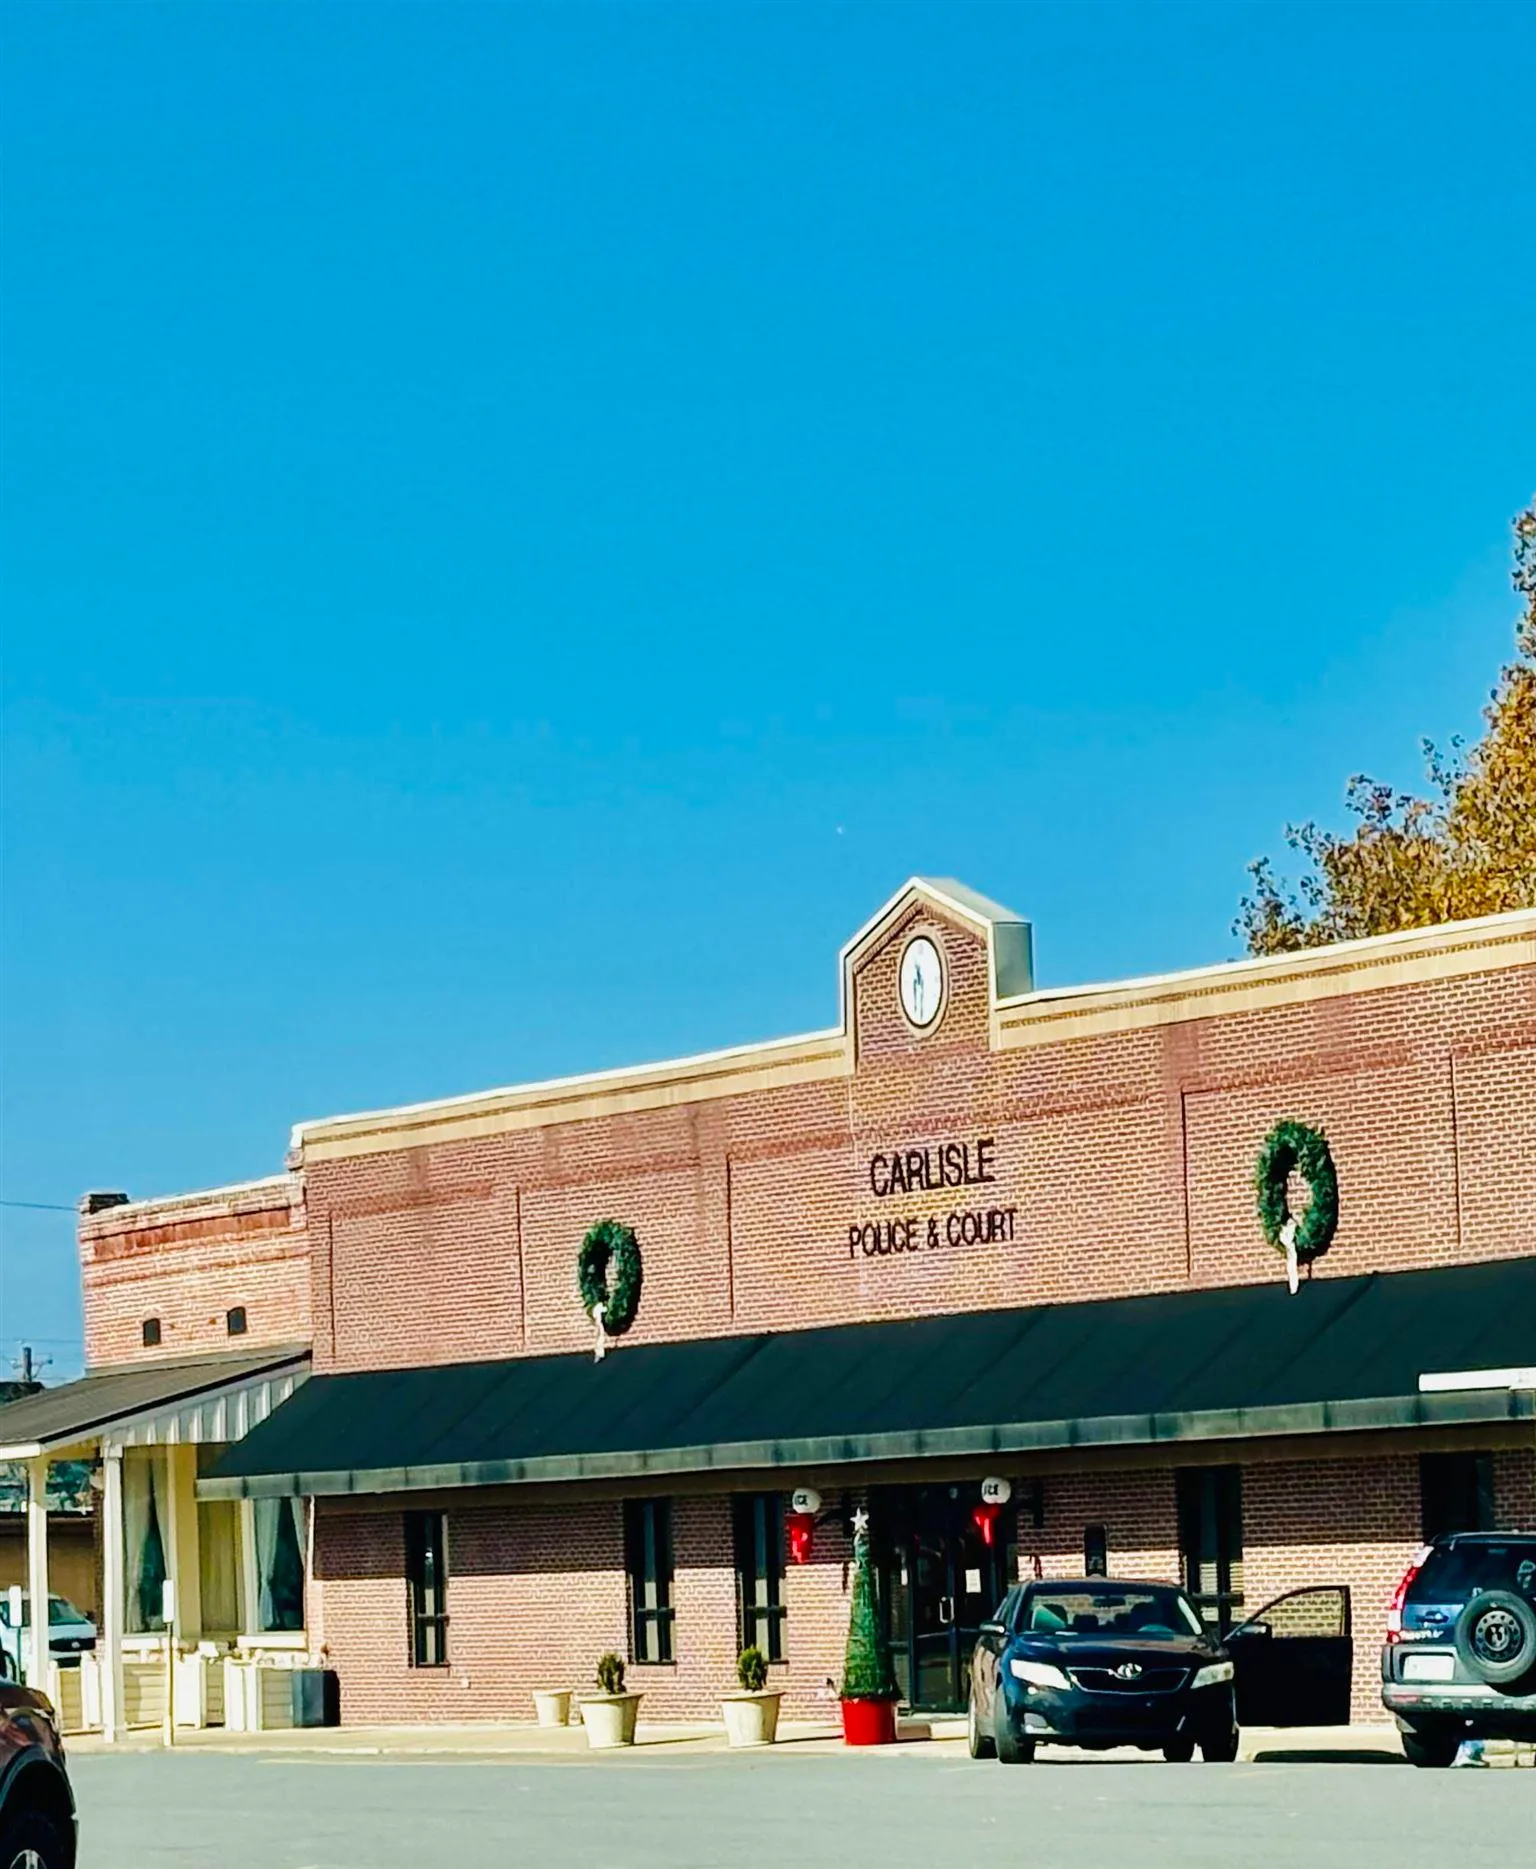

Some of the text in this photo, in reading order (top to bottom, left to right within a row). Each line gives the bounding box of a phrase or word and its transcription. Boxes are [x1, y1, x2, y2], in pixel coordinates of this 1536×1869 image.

[870, 1137, 996, 1197] CARLISLE
[849, 1208, 1018, 1259] POLICE & COURT
